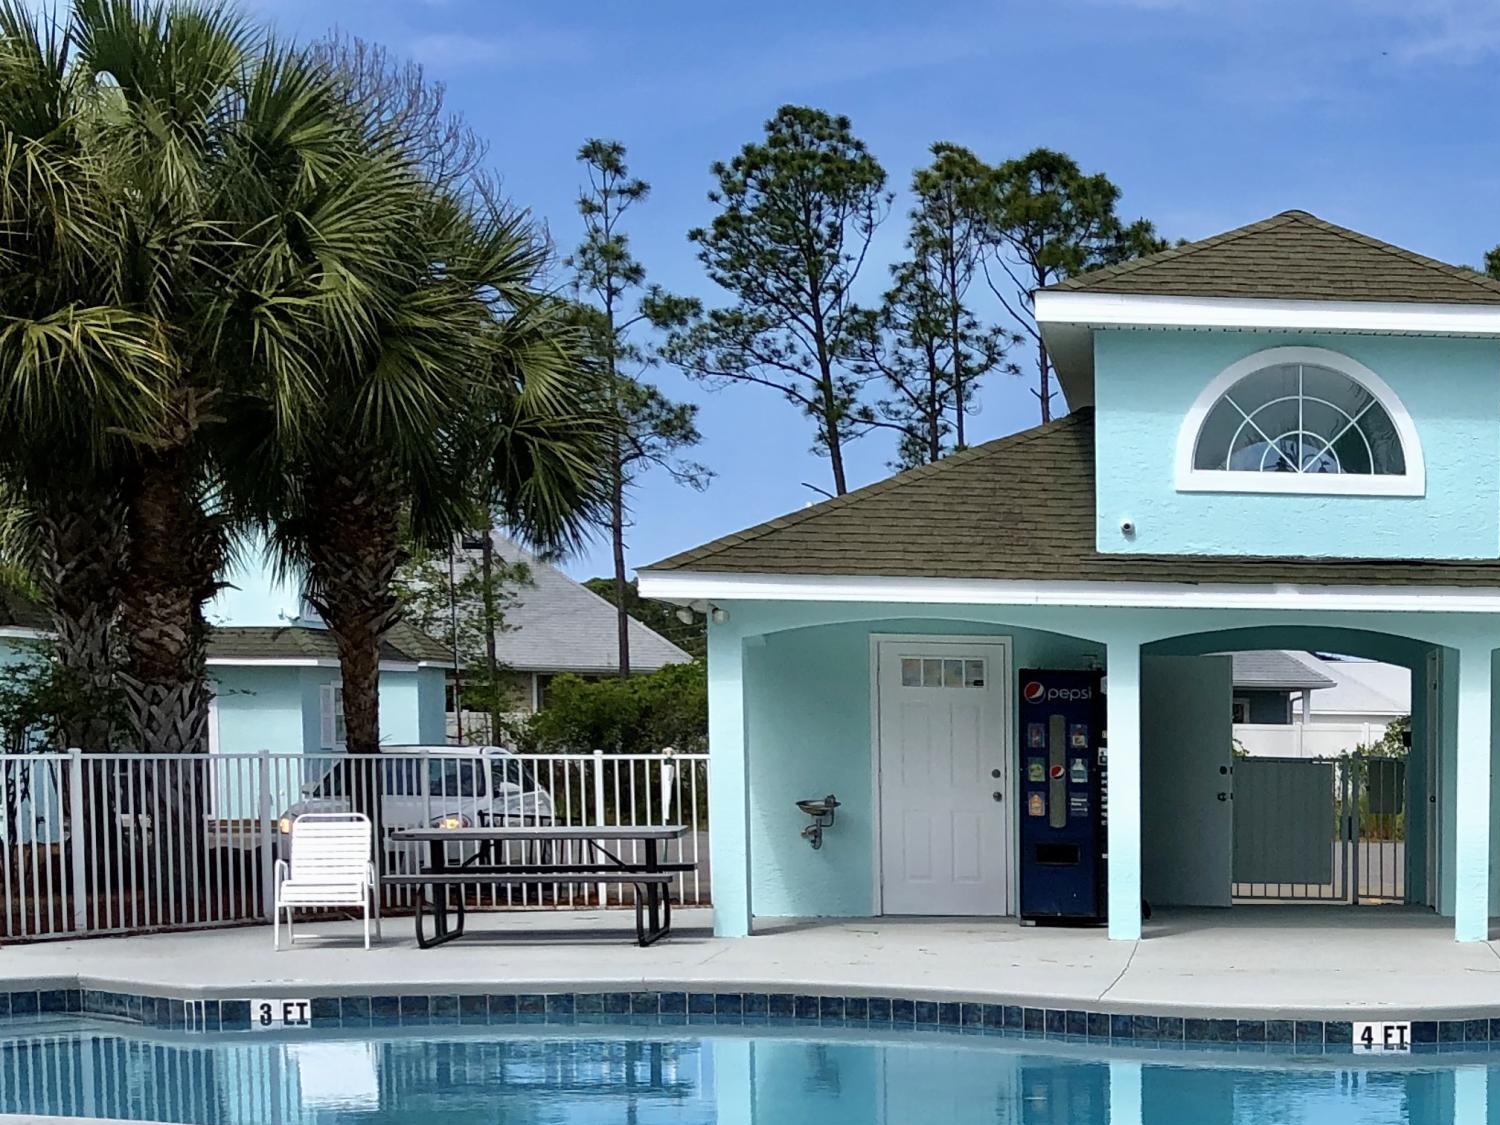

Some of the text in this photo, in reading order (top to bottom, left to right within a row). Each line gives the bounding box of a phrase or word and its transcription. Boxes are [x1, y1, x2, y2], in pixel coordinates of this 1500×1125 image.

[1048, 686, 1092, 701] pepsi
[259, 1003, 272, 1026] 3
[1360, 1025, 1374, 1049] 4
